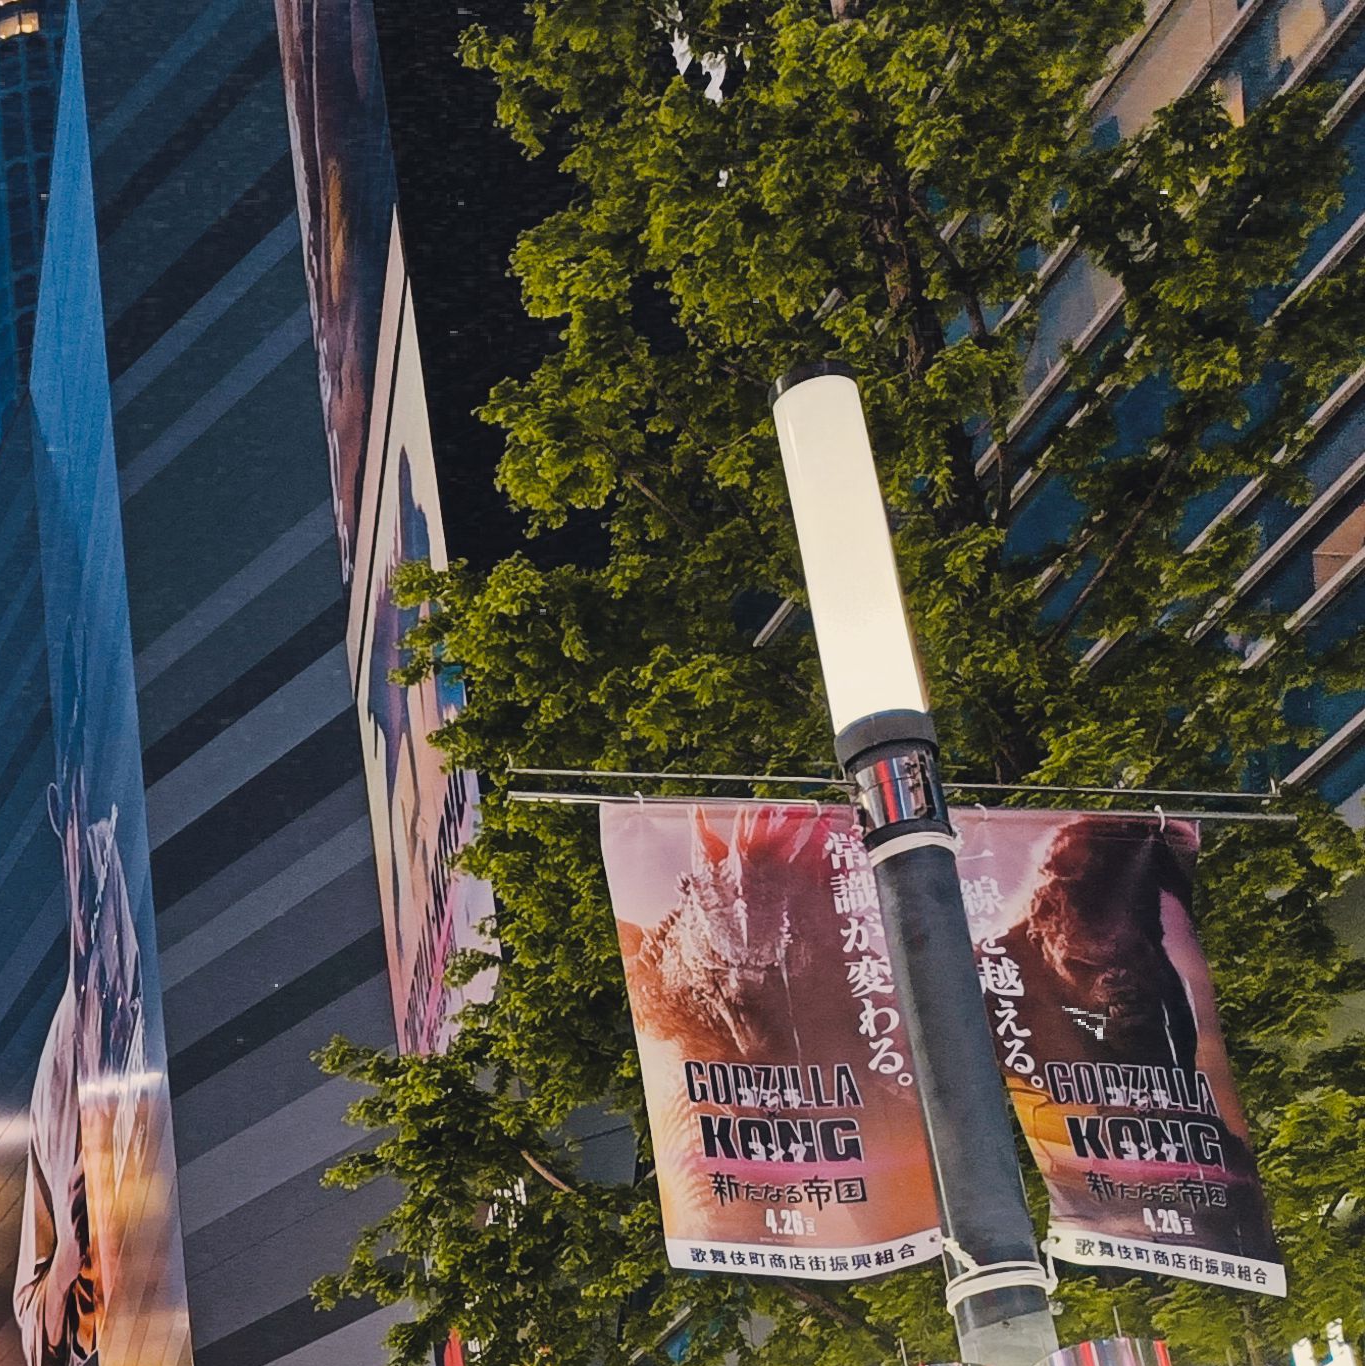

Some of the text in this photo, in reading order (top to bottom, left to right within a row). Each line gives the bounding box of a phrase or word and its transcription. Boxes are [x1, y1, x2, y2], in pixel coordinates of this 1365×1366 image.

[825, 831, 914, 1087] 常識が変わる。
[684, 1060, 865, 1109] GODZILLA
[1044, 1061, 1220, 1116] GODZILLA
[698, 1115, 865, 1163] KONG
[1065, 1115, 1226, 1173] KONG
[709, 1170, 867, 1211] 新たなる帝国
[1085, 1170, 1227, 1214] 新たなる帝国
[765, 1208, 805, 1236] 4.26
[1142, 1207, 1183, 1236] 4.26
[689, 1242, 916, 1272] 歌舞伎町商店街振興組合
[1075, 1238, 1269, 1286] 歌舞伎町商店街振興組合
